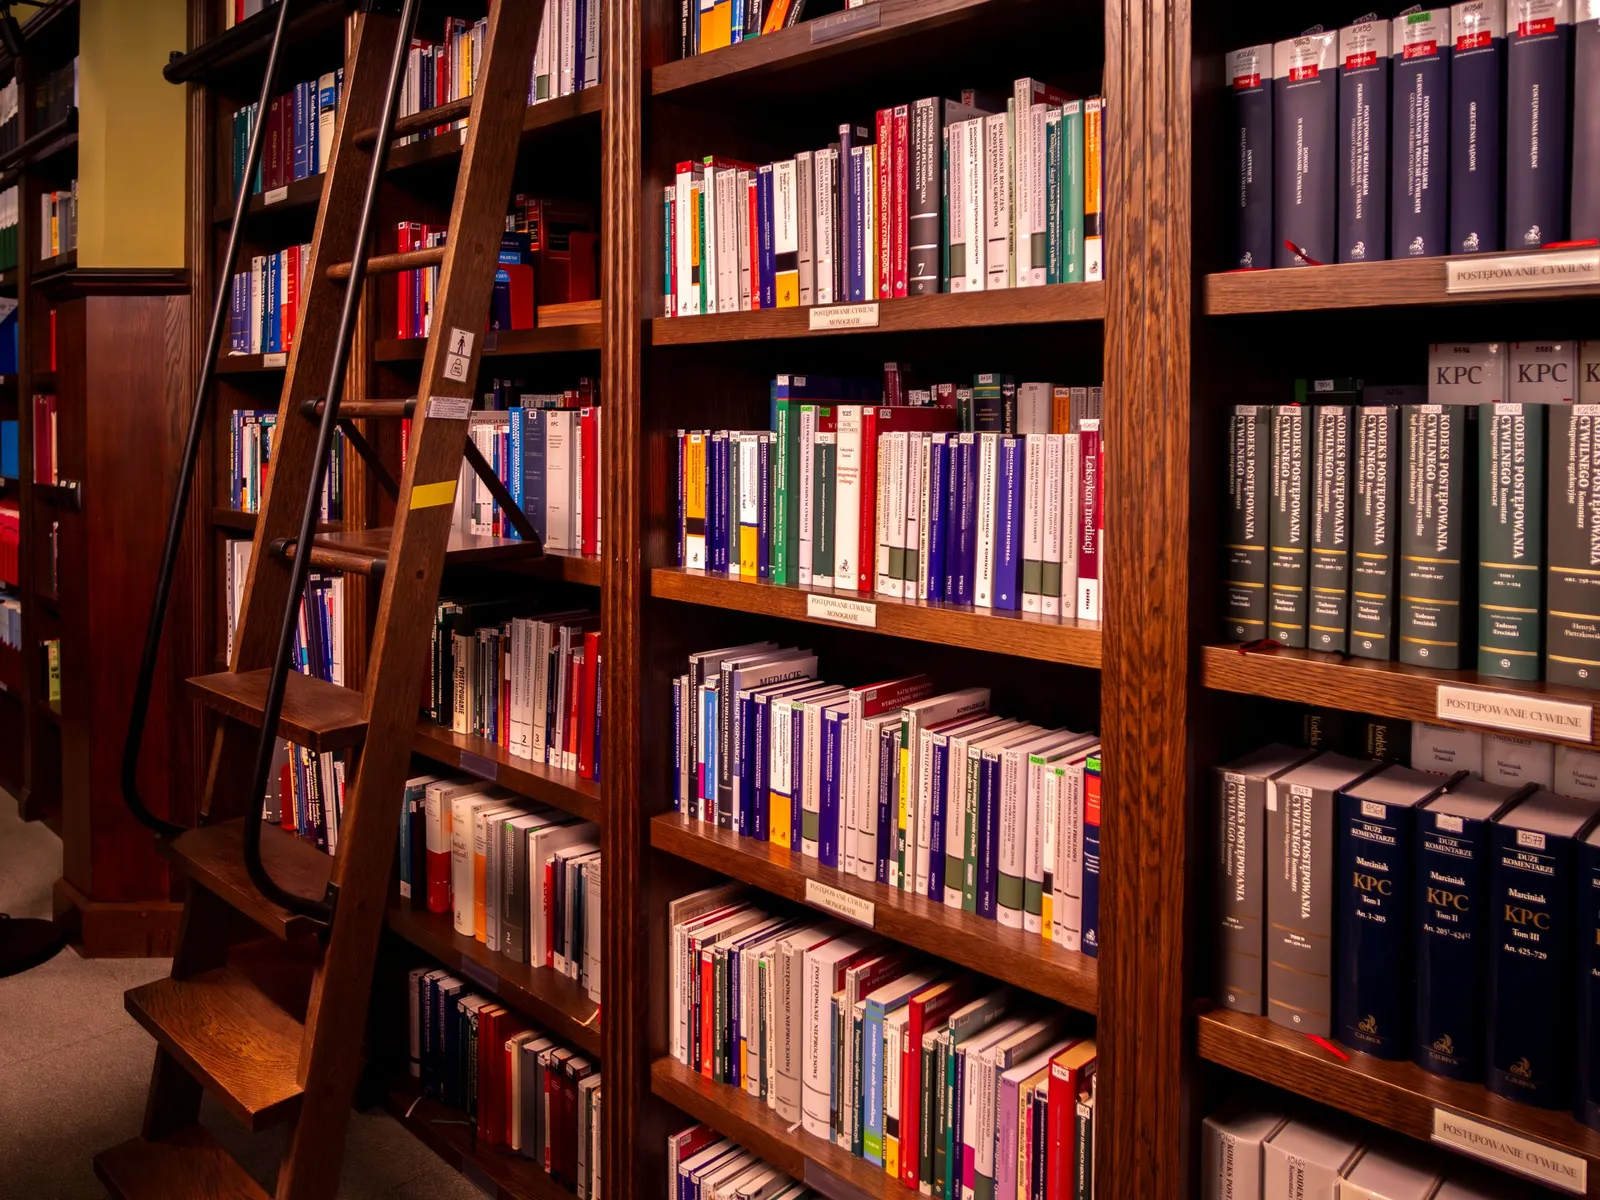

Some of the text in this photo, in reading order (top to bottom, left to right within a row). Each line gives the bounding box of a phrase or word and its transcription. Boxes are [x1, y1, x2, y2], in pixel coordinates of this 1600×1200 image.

[1415, 74, 1423, 106] PIERWSZEJ
[1415, 108, 1423, 139] INSTANCJI
[1469, 102, 1477, 172] ORZECZENIA SĄDOWE
[1531, 84, 1540, 169] POSTĘPOWANIA ODRĘBNE
[1361, 105, 1370, 195] POSTĘPOWANIE PRZED SĄDEM
[1421, 96, 1430, 189] POSTĘPOWANIE PRZED SĄDEM
[1415, 148, 1423, 177] PROCESIE
[1415, 178, 1423, 213] CYWILNYM
[918, 262, 926, 276] 7
[1457, 263, 1593, 281] POSTĘPOWANIE CYWILNE
[813, 309, 850, 317] POSTĘPOWANIE
[1436, 366, 1482, 385] KPC
[1517, 363, 1567, 382] KPC
[1237, 416, 1245, 475] CYWILNEGO
[1282, 416, 1290, 477] CYWILNEGO
[1325, 415, 1334, 477] CYWILNEGO
[1367, 415, 1376, 479] CYWILNEGO
[1427, 414, 1437, 480] CYWILNEGO
[1244, 416, 1256, 539] KODEKS POSTĘPOWANIA
[1289, 417, 1302, 543] KODEKS POSTĘPOWANIA
[1333, 415, 1346, 544] KODEKS POSTĘPOWANIA
[1374, 415, 1387, 545] KODEKS POSTĘPOWANIA
[1435, 415, 1450, 552] KODEKS POSTĘPOWANIA
[1500, 416, 1511, 524] CYWILNEGO Komentarz
[1578, 416, 1590, 529] CYWILNEGO Komentarz
[1510, 416, 1524, 559] KODEKS POSTĘPOWANIA
[1083, 455, 1096, 555] Leksykon mediacji
[811, 598, 848, 609] POSTĘPOWANIE
[759, 669, 802, 686] MEDIACJE
[1446, 698, 1582, 727] POSTĘPOWANIE CYWILNE
[522, 735, 527, 743] 2
[535, 733, 540, 742] 3
[971, 779, 979, 806] pozwanego
[922, 800, 930, 819] Problemy
[971, 813, 979, 832] procesie
[1227, 783, 1236, 842] CYWILNEGO
[922, 821, 930, 841] praktyczne
[1234, 784, 1246, 901] KODEKS POSTĘPOWANIA
[1352, 828, 1396, 843] KOMENTARZE
[1364, 824, 1382, 833] DUŻE
[1439, 837, 1459, 847] DUŻE
[971, 833, 979, 856] cywilnym
[1291, 795, 1301, 892] CYWILNEGO Komentarz
[1300, 797, 1312, 918] KODEKS POSTĘPOWANIA
[1425, 842, 1473, 857] KOMENTARZE
[1356, 856, 1389, 871] Marciniak
[1502, 857, 1554, 873] KOMENTARZE
[1518, 853, 1539, 863] DUŻE
[1353, 872, 1392, 896] KPC
[1430, 871, 1465, 886] Marciniak
[1362, 895, 1376, 904] Tom
[1427, 887, 1469, 911] KPC
[1508, 888, 1546, 903] Marciniak
[1356, 910, 1367, 919] Art.
[1436, 911, 1450, 920] Tom
[1504, 905, 1550, 930] KPC
[1504, 943, 1516, 952] Art.
[1512, 928, 1539, 941] Tom III
[783, 956, 791, 1073] POSTĘPOWANIE NIEPROCESOWE
[812, 966, 820, 1080] POSTĘPOWANIE NIEPROCESOWE
[1226, 1144, 1237, 1178] KODEKS
[1443, 1123, 1577, 1178] POSTĘPOWANIE CYWILNE
